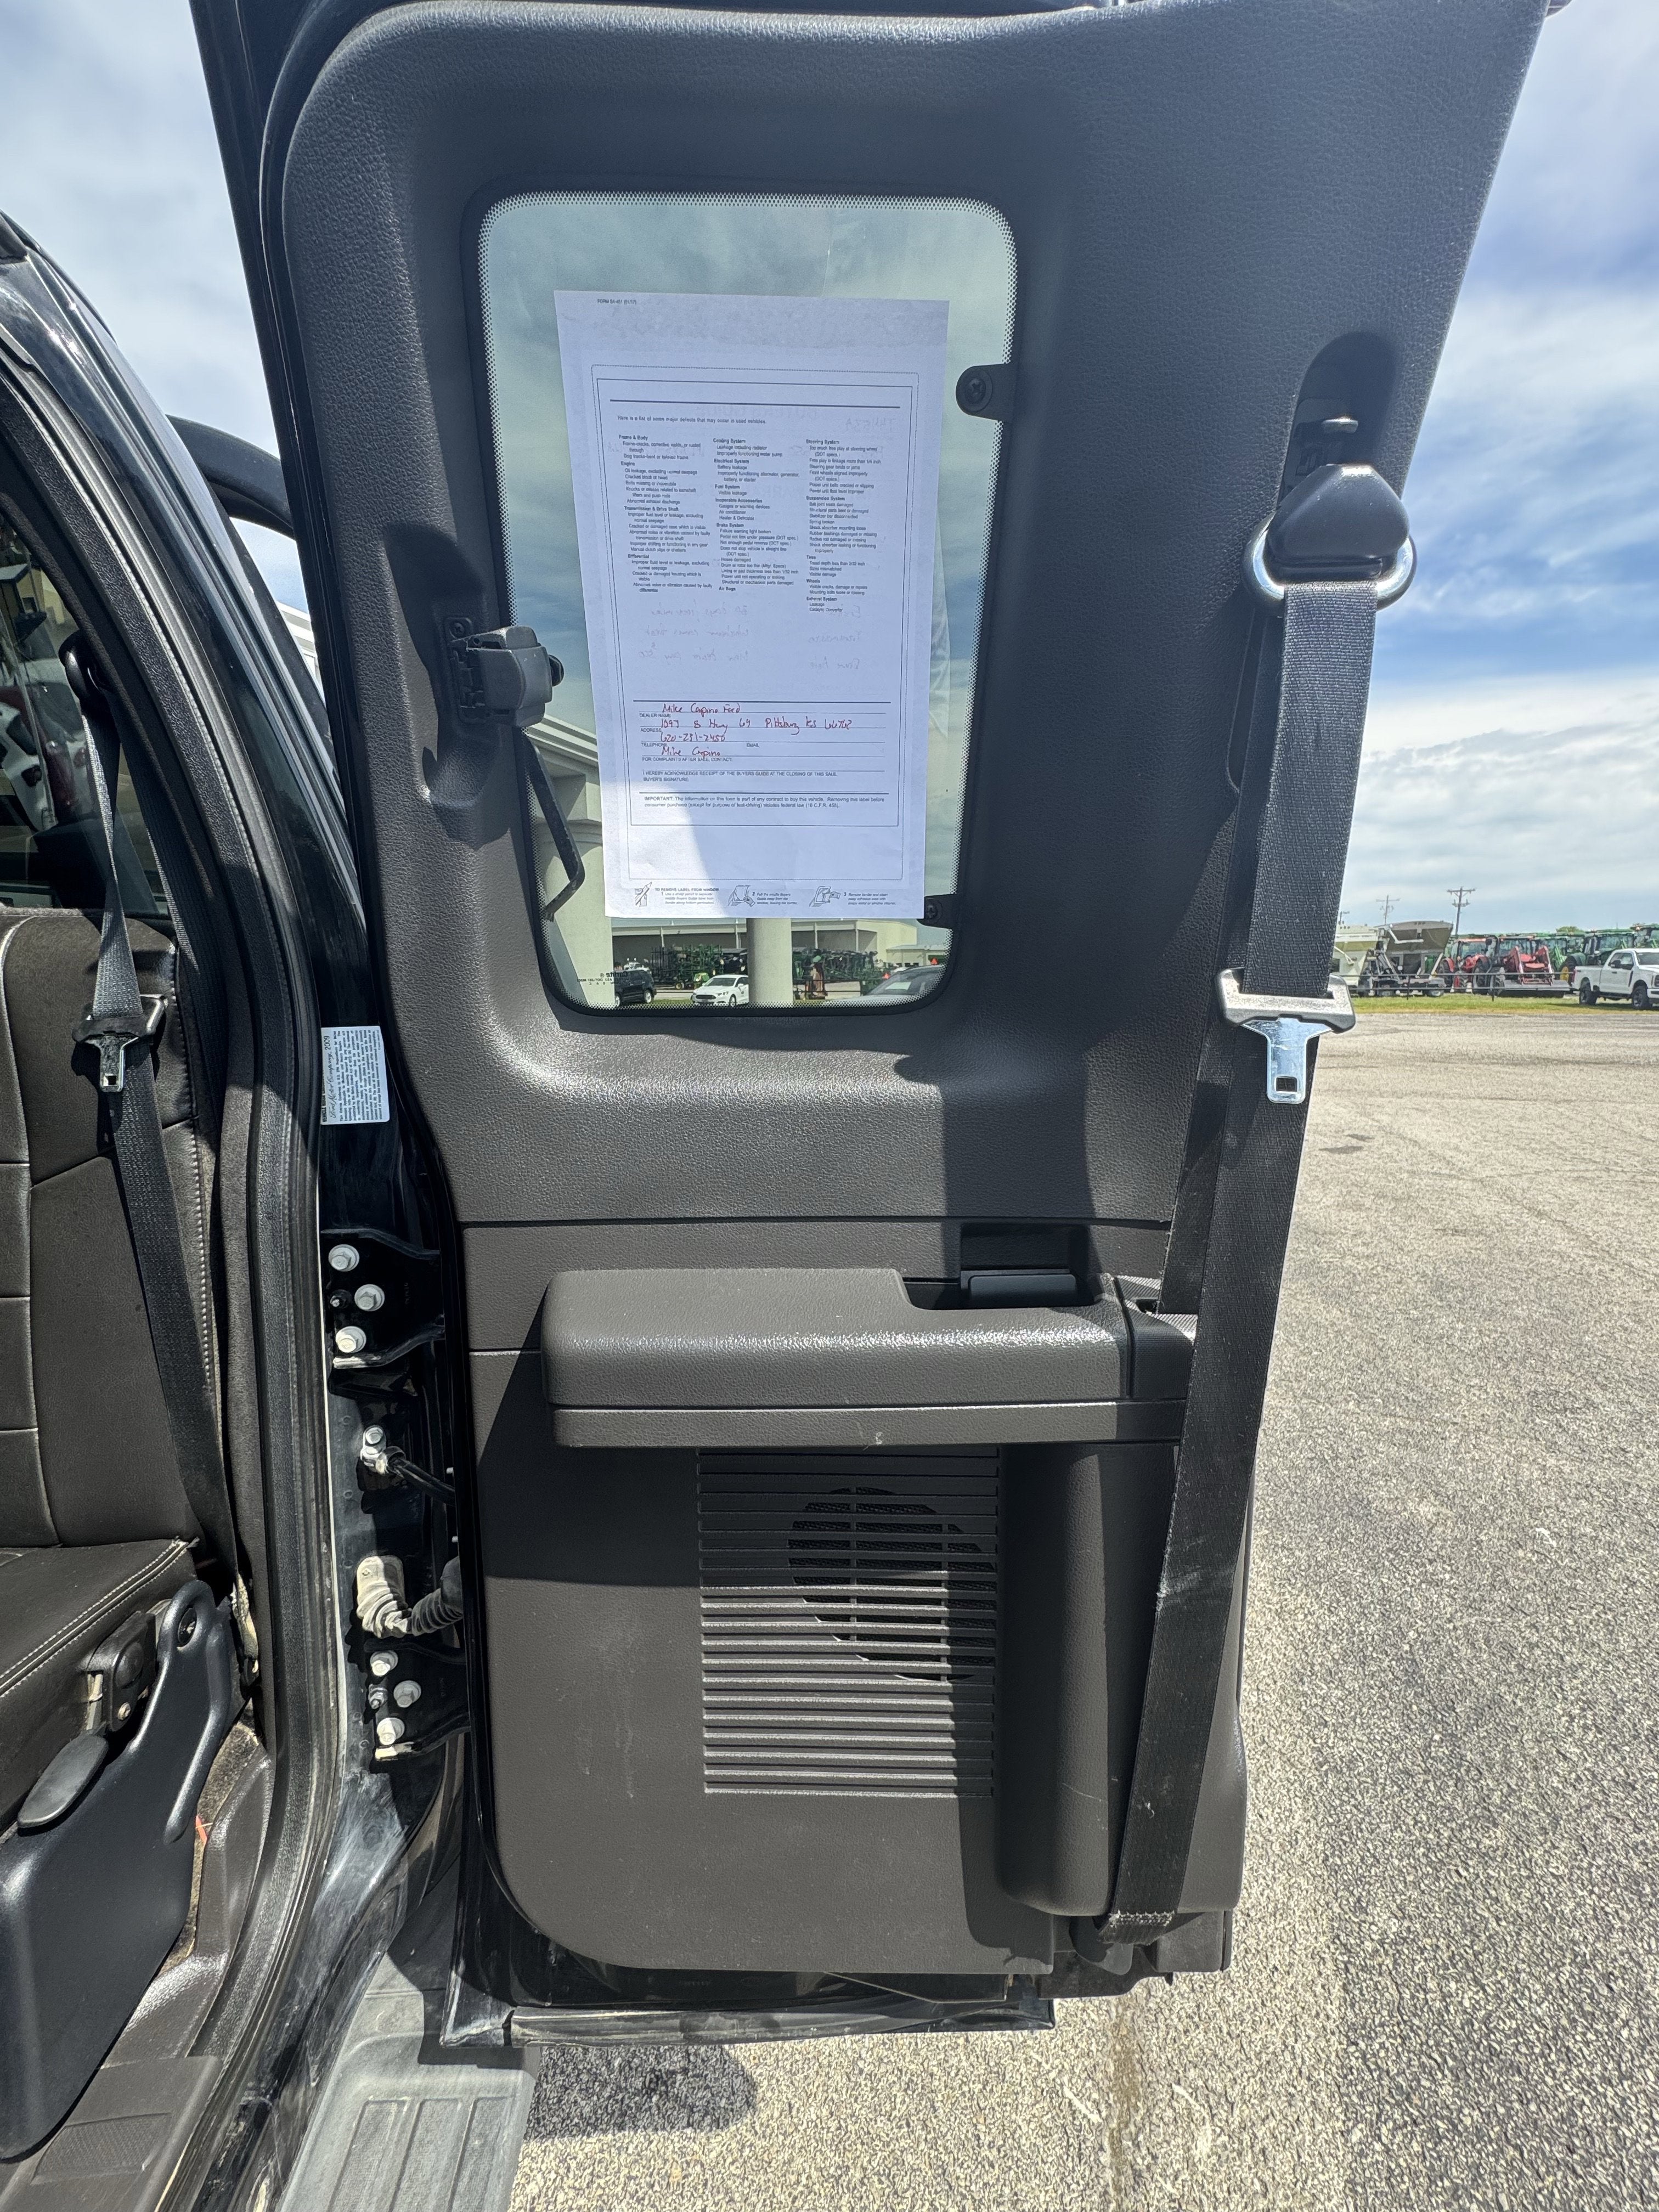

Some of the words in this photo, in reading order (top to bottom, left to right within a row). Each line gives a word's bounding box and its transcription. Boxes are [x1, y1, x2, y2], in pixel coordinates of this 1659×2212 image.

[662, 703, 682, 713] Mike
[723, 703, 740, 713] Ford
[662, 746, 681, 756] Mike
[327, 1084, 336, 1104] Motor
